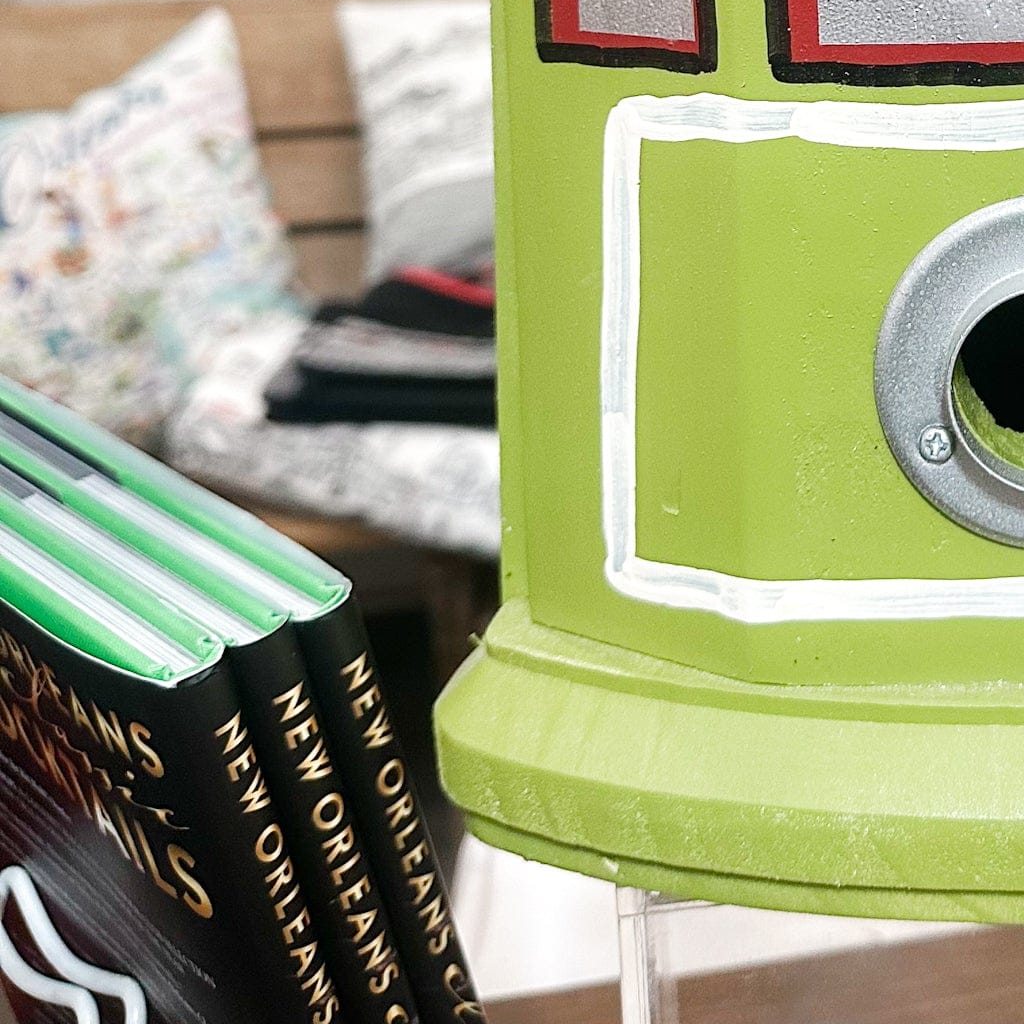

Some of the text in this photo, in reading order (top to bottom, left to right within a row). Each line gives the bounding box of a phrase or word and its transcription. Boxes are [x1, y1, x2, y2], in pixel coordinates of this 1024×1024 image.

[214, 709, 339, 1024] NEW ORLEANS
[272, 680, 399, 994] NEW ORLEANS
[340, 651, 451, 955] NEW ORLEANS
